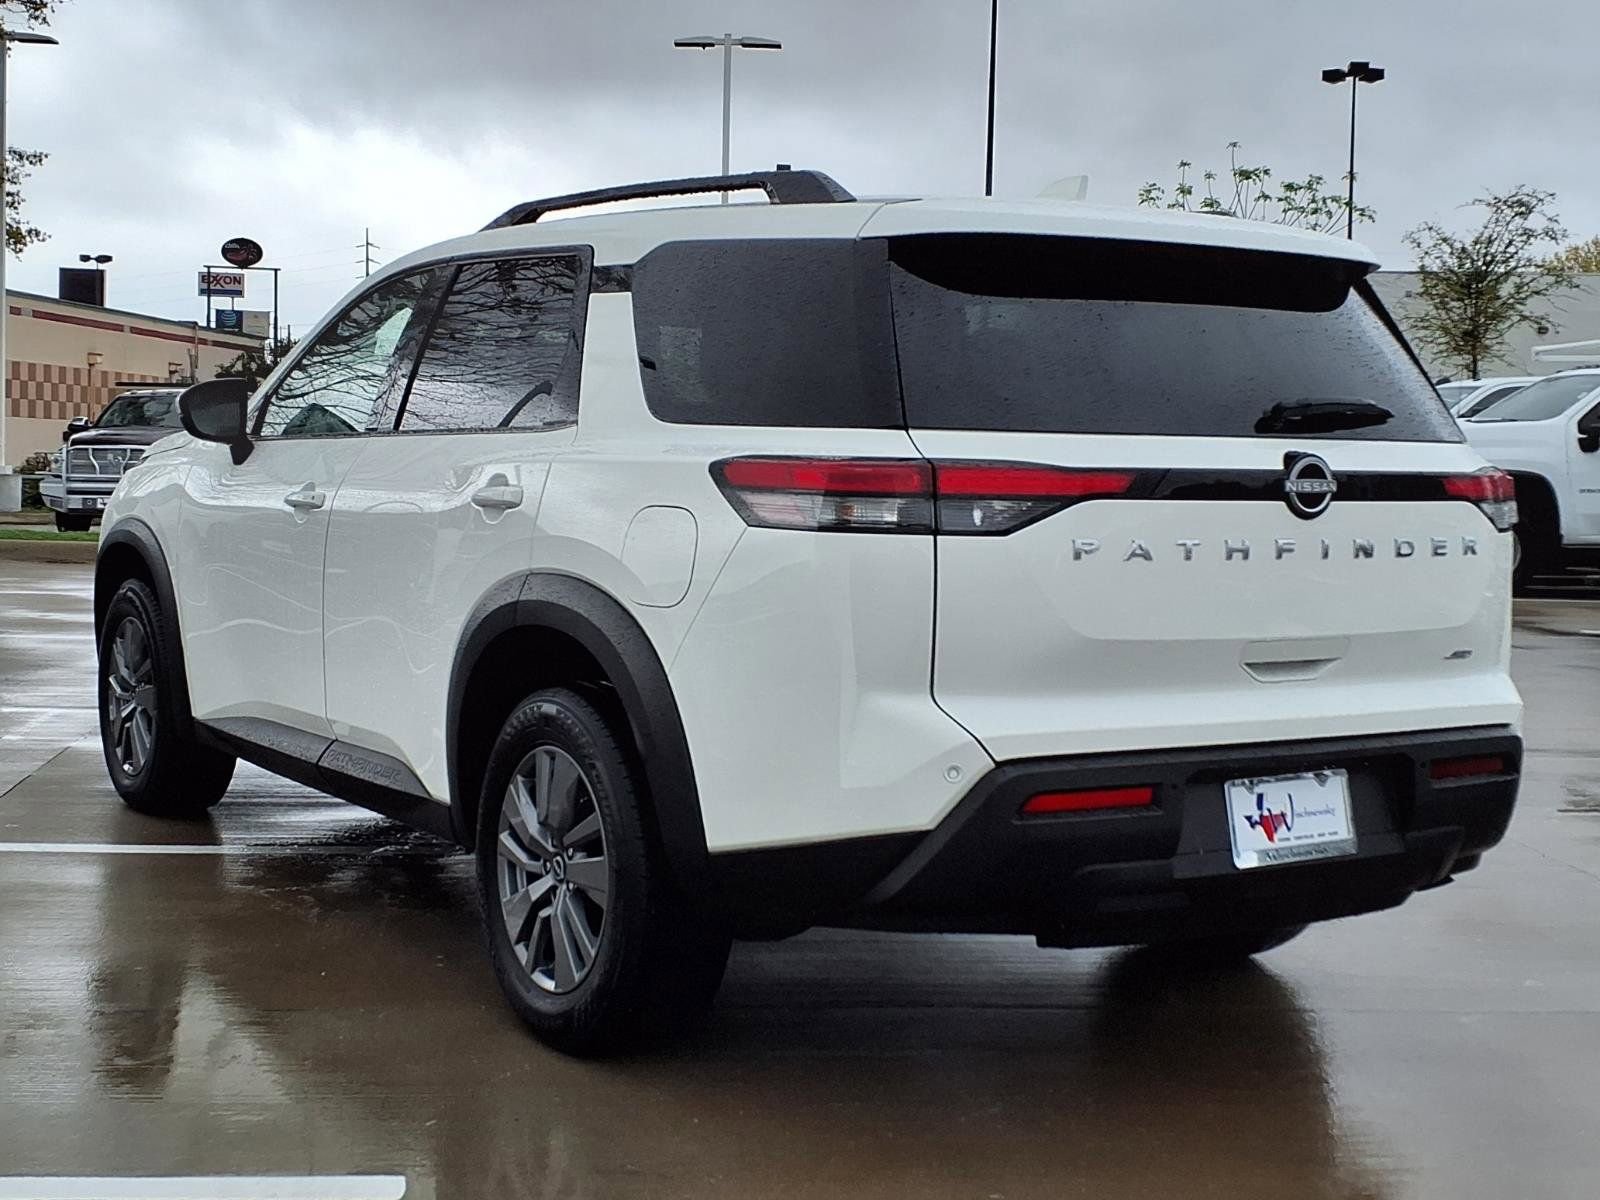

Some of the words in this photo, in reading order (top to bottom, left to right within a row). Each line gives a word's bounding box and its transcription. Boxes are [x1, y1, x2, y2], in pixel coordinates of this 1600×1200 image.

[201, 274, 242, 288] EXXON
[1286, 481, 1337, 493] NISSAN
[1072, 536, 1478, 562] PATHFINDER
